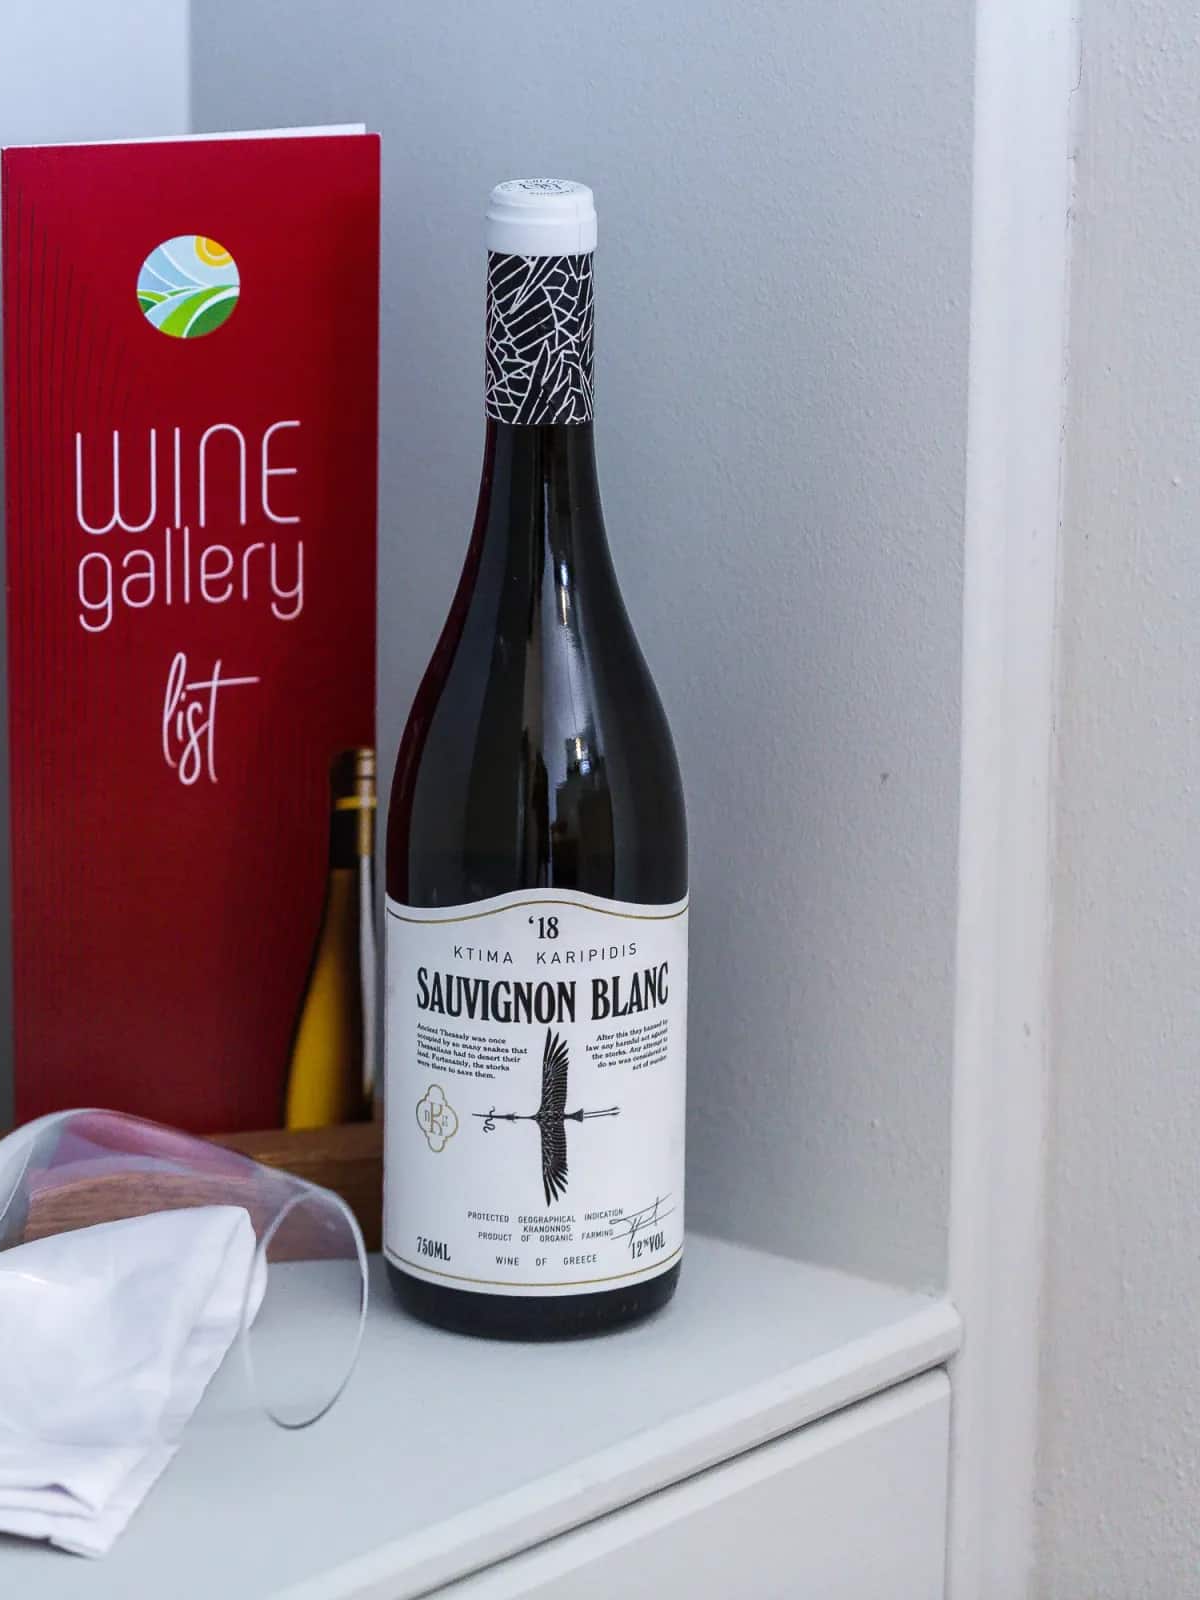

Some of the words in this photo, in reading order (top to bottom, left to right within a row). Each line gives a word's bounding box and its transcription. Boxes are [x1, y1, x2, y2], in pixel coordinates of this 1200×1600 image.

[75, 420, 301, 535] WINE
[78, 526, 304, 633] gallery
[162, 652, 261, 786] list
[454, 945, 514, 965] KTIMA
[536, 942, 637, 965] KARIPIDIS
[416, 966, 576, 1025] SAUVIGNON
[591, 961, 669, 1021] BLANC
[616, 1031, 628, 1039] this
[467, 1210, 509, 1223] PROTECTED
[518, 1215, 576, 1224] GEOGRAPHICAL
[584, 1208, 624, 1221] INDICATION
[478, 1231, 512, 1242] PRODUCT
[521, 1234, 531, 1242] OF
[539, 1234, 574, 1242] ORGANIC
[581, 1228, 614, 1240] FARMING
[417, 1236, 451, 1261] 750ML
[495, 1256, 520, 1266] WINE
[535, 1257, 547, 1266] OF
[563, 1254, 597, 1266] GREECE
